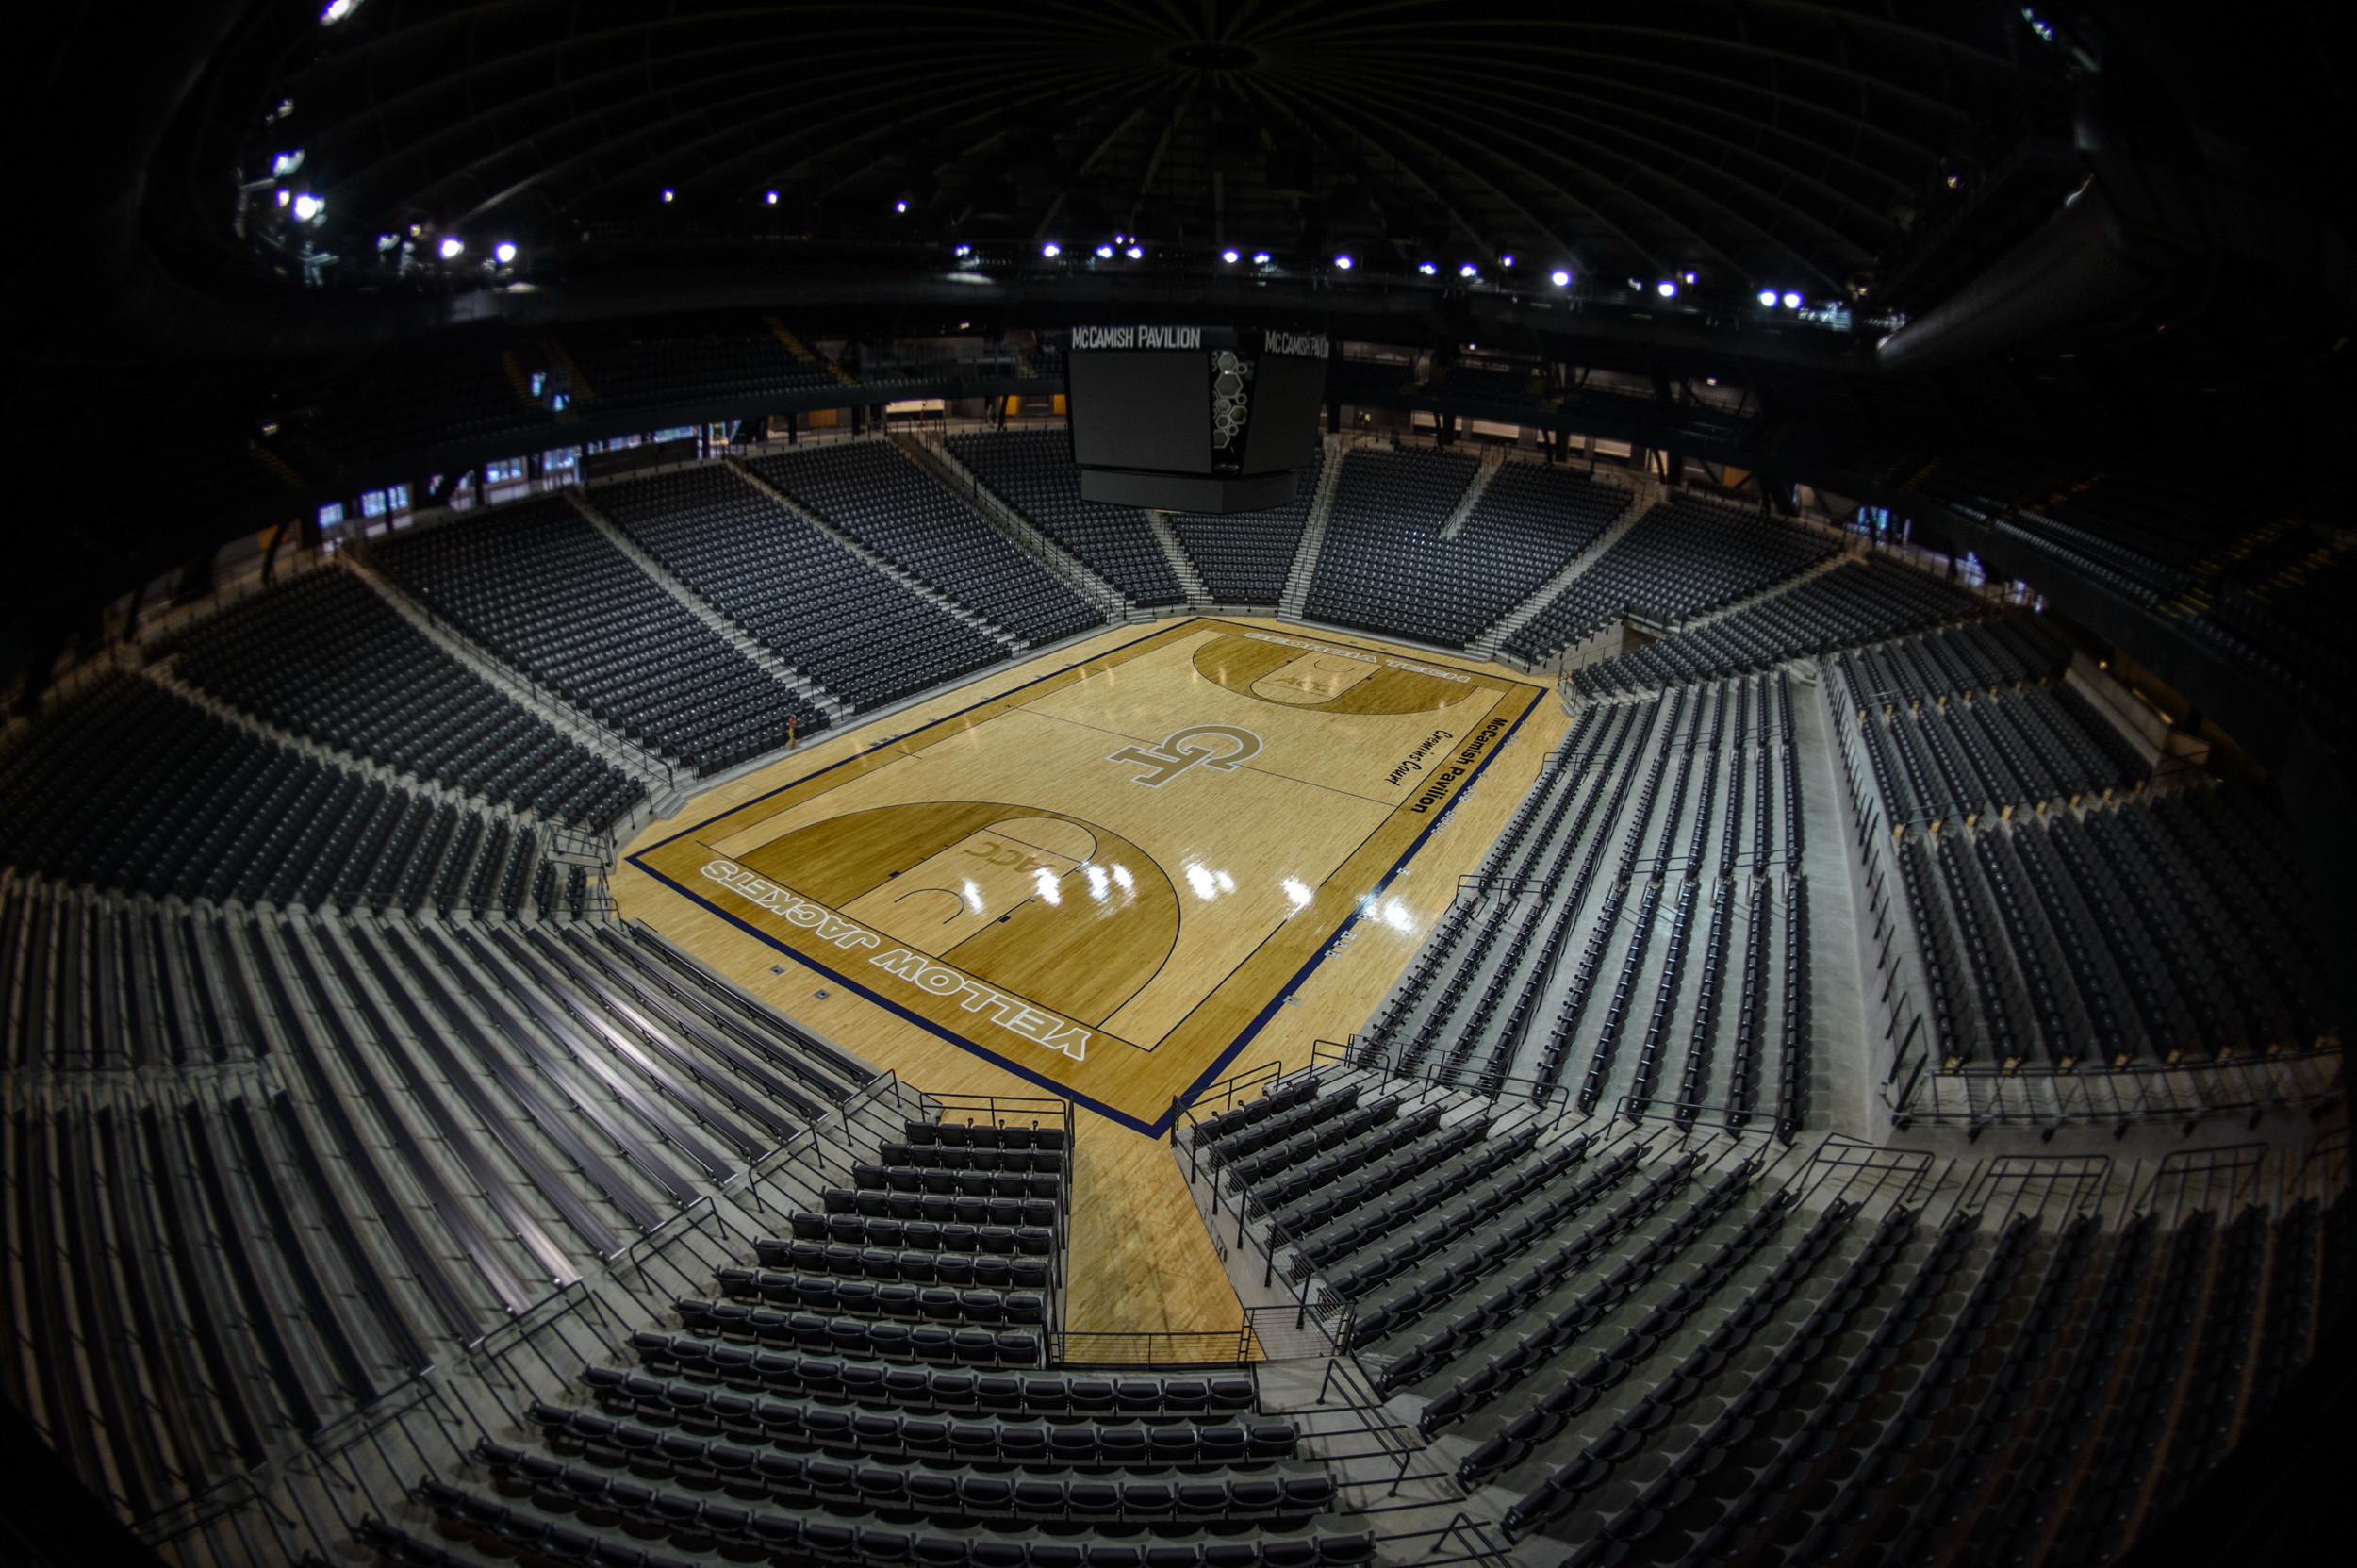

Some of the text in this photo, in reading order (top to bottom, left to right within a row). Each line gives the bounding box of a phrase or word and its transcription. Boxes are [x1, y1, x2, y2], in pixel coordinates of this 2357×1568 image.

[1138, 324, 1201, 349] PAVILION
[1244, 632, 1471, 684] GEORGIA TECH
[1410, 717, 1508, 814] McCamish Pavilion
[964, 840, 1057, 873] ACC
[701, 859, 1092, 1062] YELLOW JACKETS
